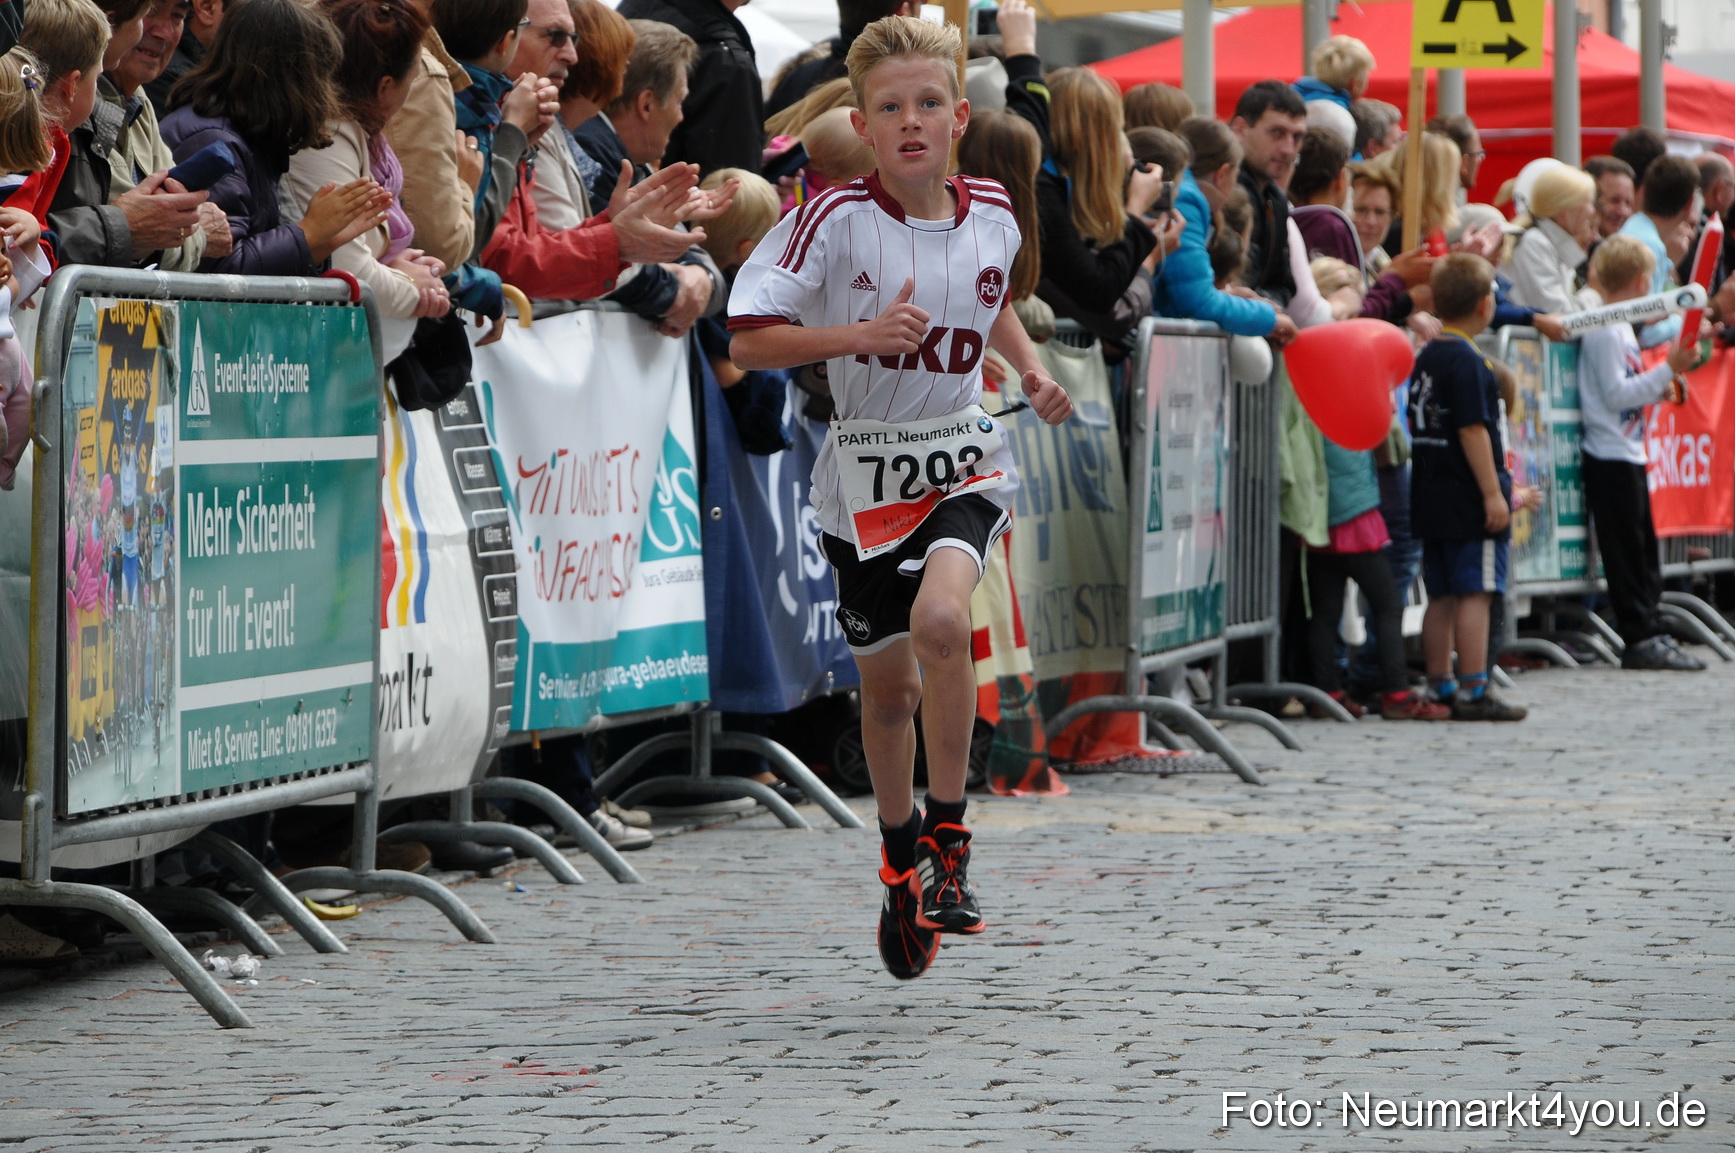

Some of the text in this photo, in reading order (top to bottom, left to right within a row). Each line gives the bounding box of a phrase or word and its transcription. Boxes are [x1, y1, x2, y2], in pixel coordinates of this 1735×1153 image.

[851, 282, 877, 292] adidas
[980, 283, 1001, 297] FCN
[111, 357, 147, 412] erdgas
[214, 351, 310, 404] Event-Leit-Systeme
[837, 422, 972, 447] PARTL Neumarkt
[187, 483, 316, 558] Mehr Sicherheit
[187, 583, 296, 657] für Ihr Event!
[846, 618, 869, 632] FCN
[188, 707, 337, 770] Miet & Service Line: 09181 6352
